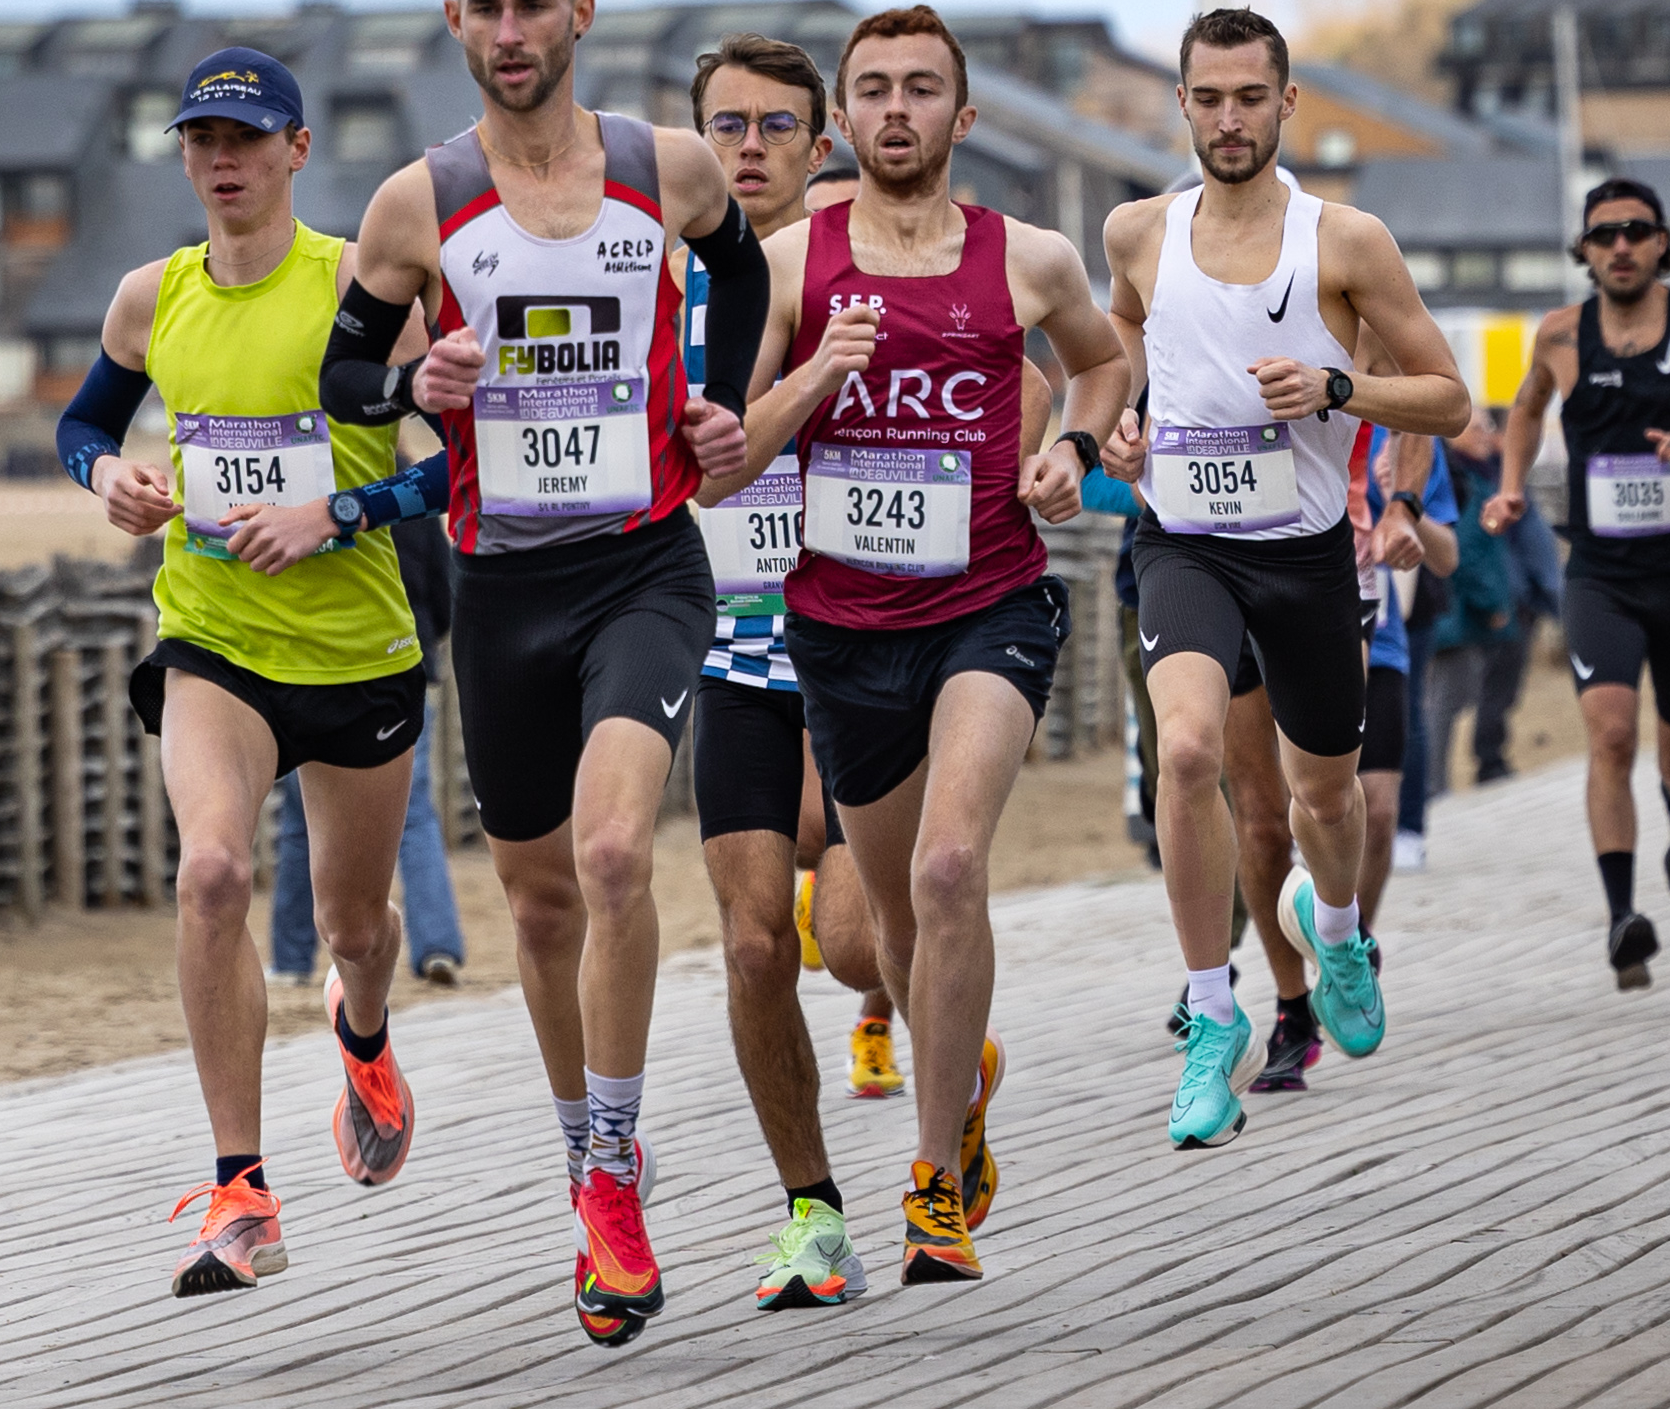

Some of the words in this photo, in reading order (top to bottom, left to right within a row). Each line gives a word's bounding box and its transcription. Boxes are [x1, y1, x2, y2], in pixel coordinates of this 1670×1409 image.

[486, 392, 507, 404] 5KM
[518, 387, 598, 399] Marathon
[832, 369, 987, 420] ARC
[518, 395, 598, 407] International
[208, 418, 281, 429] Marathon
[208, 427, 282, 438] International
[886, 428, 950, 443] Running
[954, 429, 987, 442] Club
[1186, 430, 1249, 439] Marathon
[522, 425, 601, 468] 3047
[1186, 436, 1250, 445] International
[823, 449, 842, 461] 5KM
[850, 449, 926, 461] Marathon
[850, 458, 926, 470] International
[214, 455, 286, 495] 3154
[1188, 460, 1257, 494] 3054
[538, 476, 588, 494] JEREMY
[1614, 482, 1664, 508] 3035
[847, 487, 925, 529] 3243
[1209, 501, 1242, 515] KEVIN
[854, 535, 916, 554] VALENTIN
[907, 564, 926, 573] CLUB
